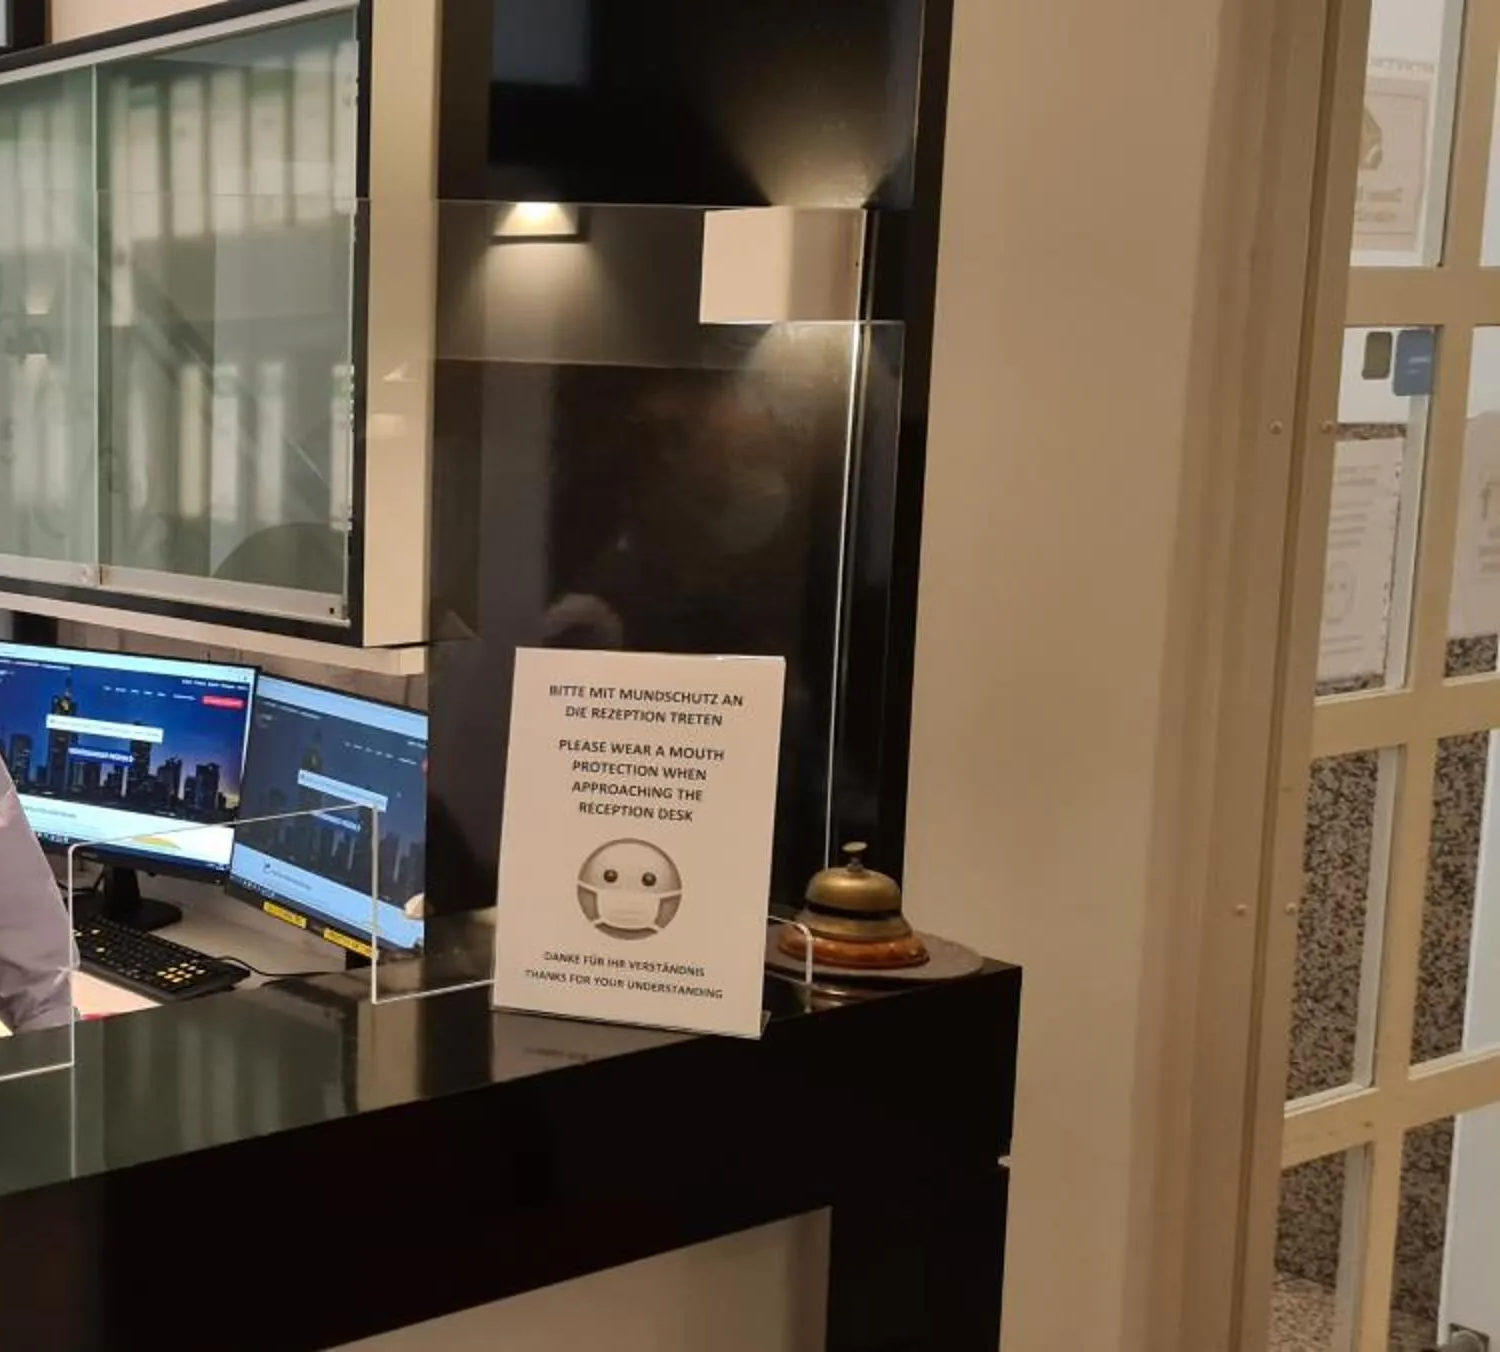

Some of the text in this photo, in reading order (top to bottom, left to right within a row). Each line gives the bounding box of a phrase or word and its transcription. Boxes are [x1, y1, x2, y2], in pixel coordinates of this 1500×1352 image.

[549, 685, 744, 707] BITTE MIT MUNDSCHUTZ AN
[565, 706, 723, 727] DIE REZEPTION TRETEN
[559, 739, 725, 762] PLEASE WEAR A MOUTH
[572, 760, 707, 781] PROTECTION WHEN
[572, 781, 703, 802] APPROACHING THE
[579, 801, 694, 822] RECEPTION DESK
[543, 951, 706, 978] DANKE FÜR IHR VERSTÄNDNIS
[525, 969, 724, 1000] THANKS FOR YOUR UNDERSTANDING
